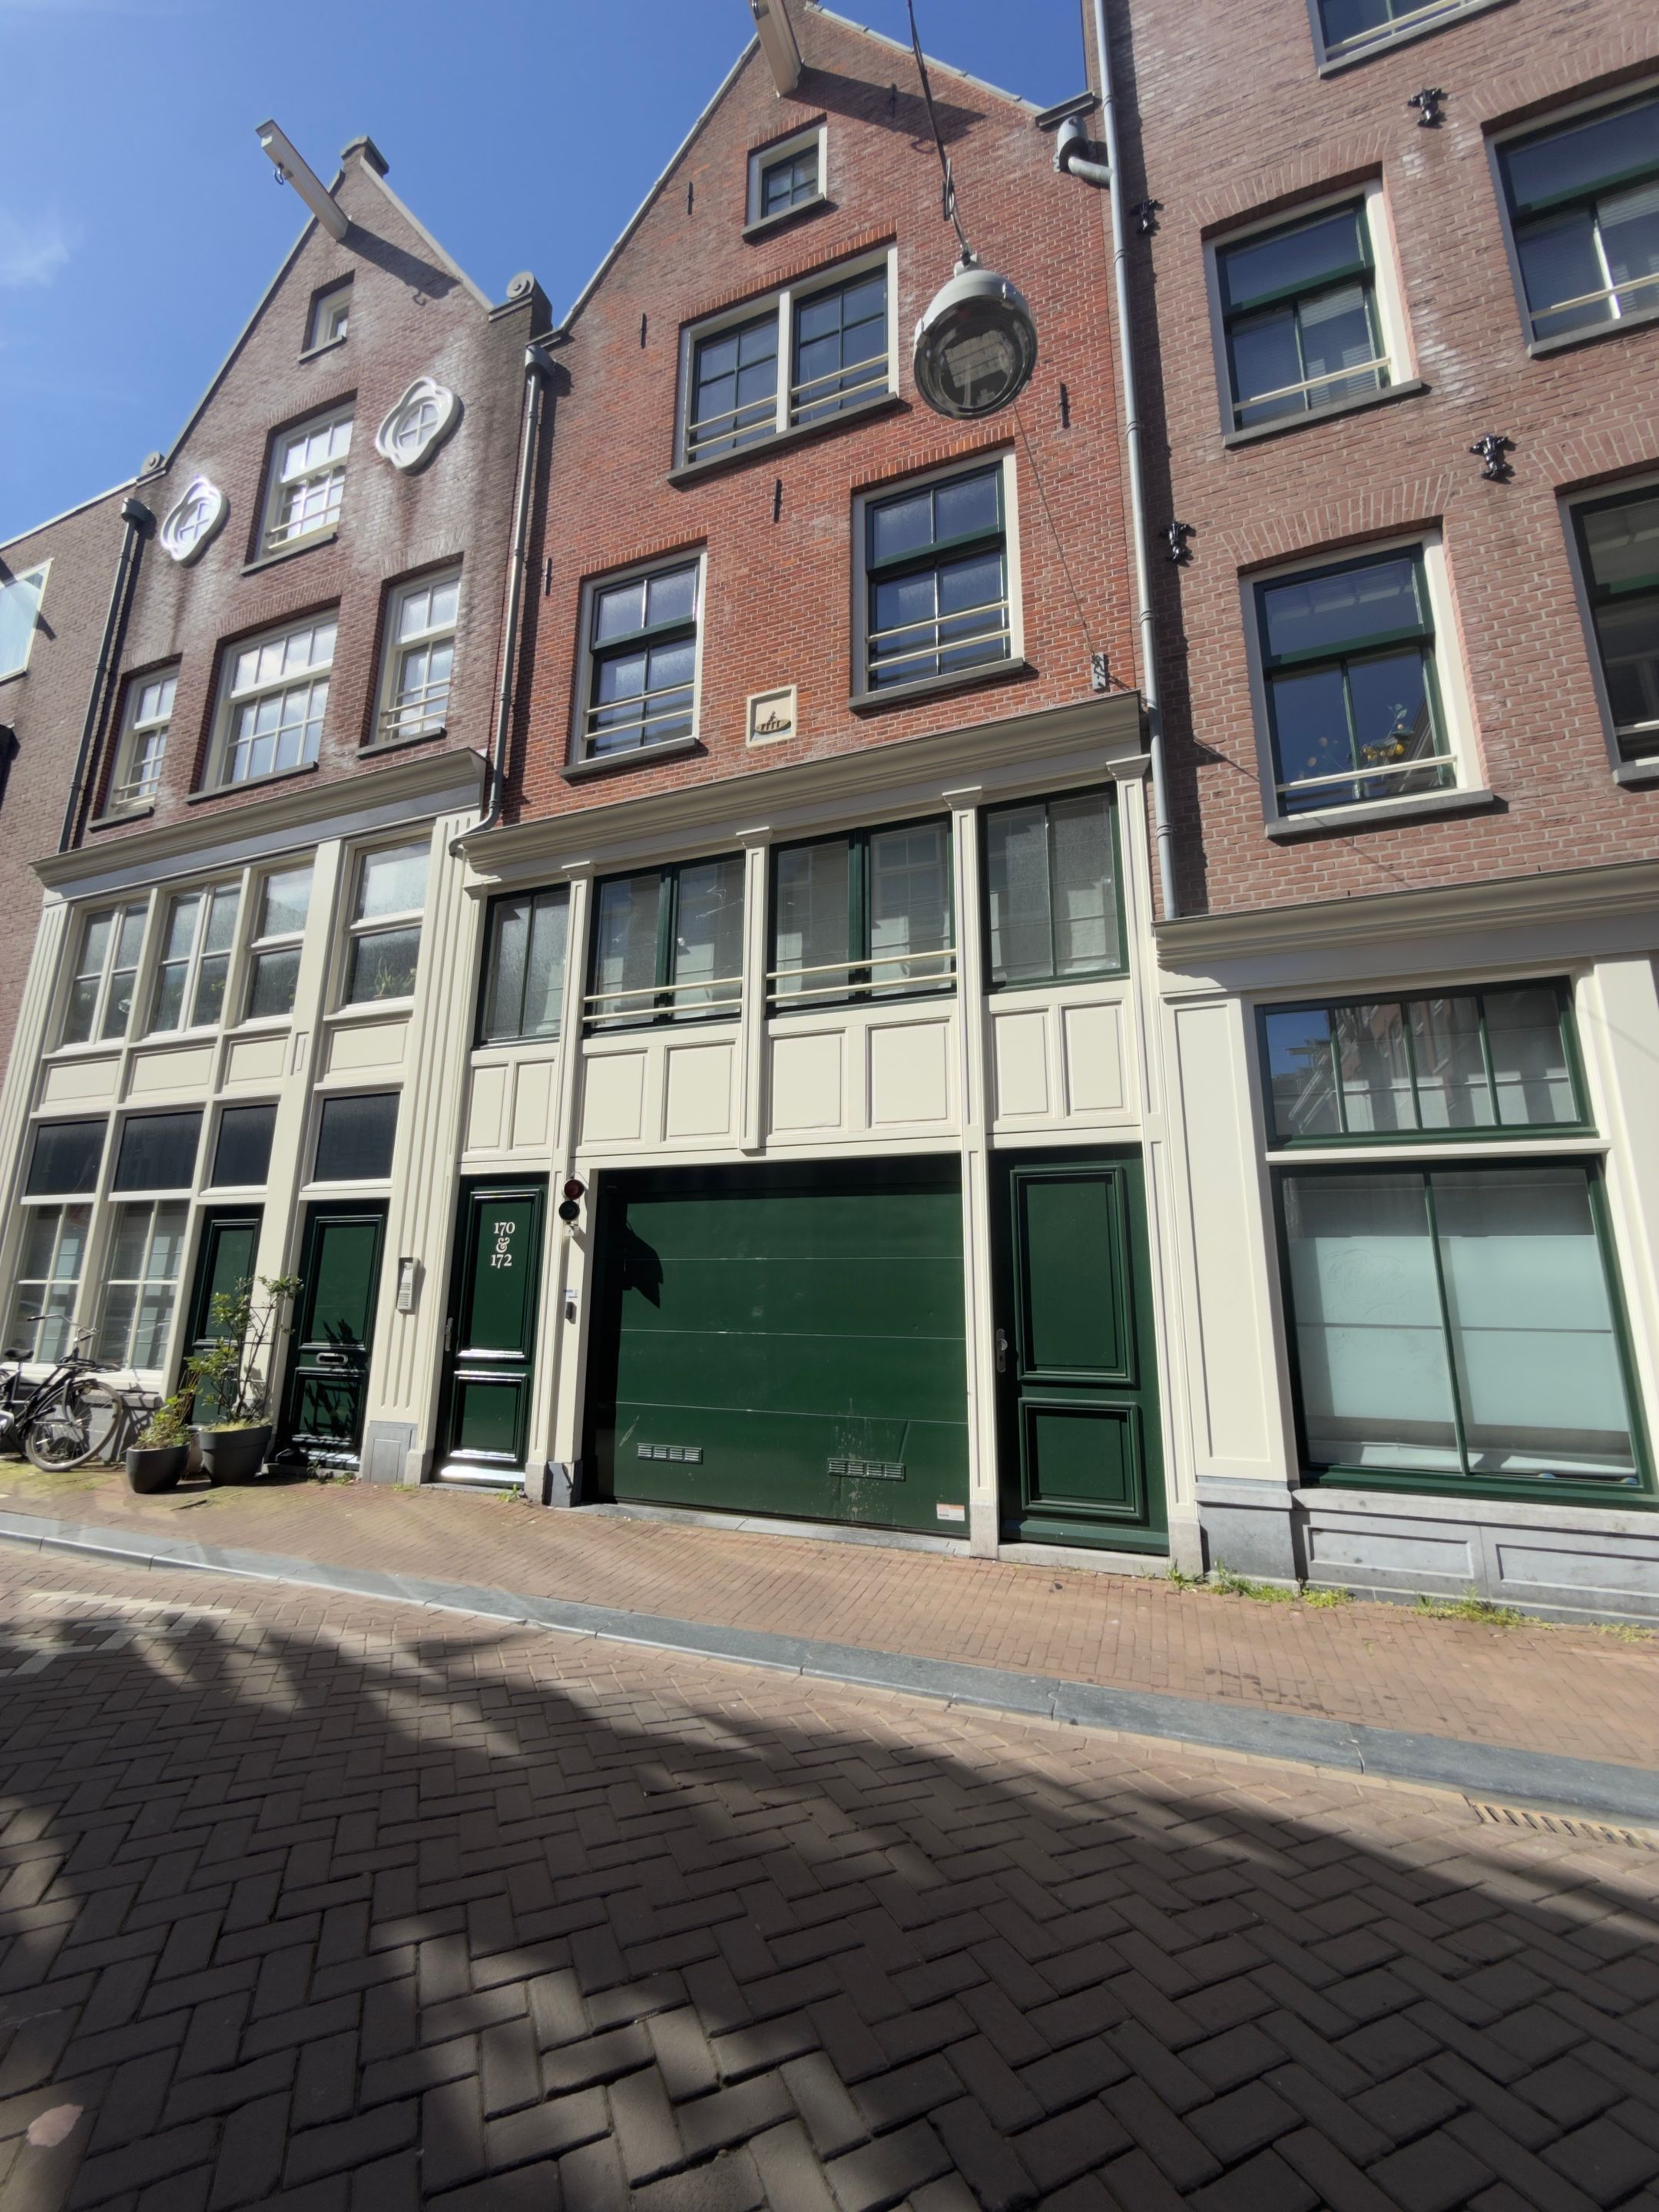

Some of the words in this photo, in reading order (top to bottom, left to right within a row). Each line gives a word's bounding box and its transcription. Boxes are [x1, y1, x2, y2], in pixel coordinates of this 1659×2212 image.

[493, 1221, 515, 1237] 170
[495, 1237, 510, 1253] &
[491, 1253, 512, 1269] 172
